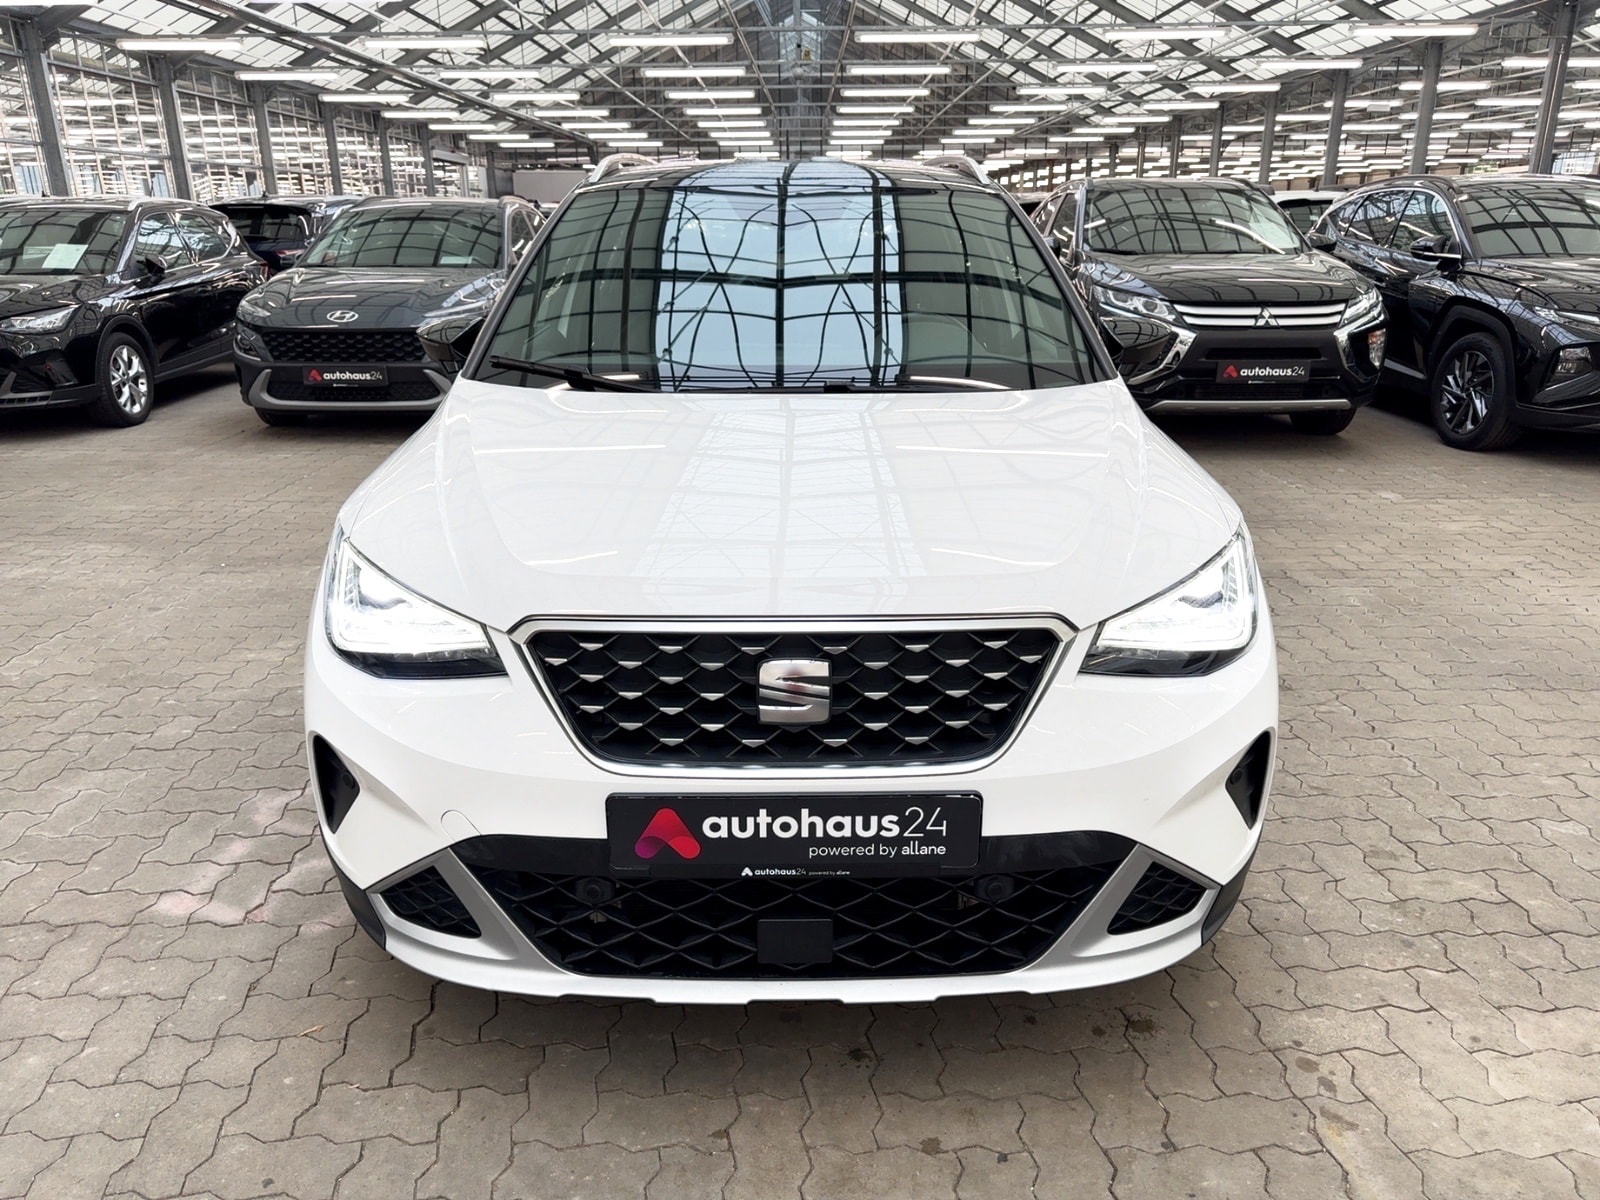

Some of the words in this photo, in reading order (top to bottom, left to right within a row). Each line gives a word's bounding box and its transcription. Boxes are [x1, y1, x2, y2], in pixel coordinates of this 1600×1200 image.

[323, 371, 383, 380] autohaus24
[1240, 366, 1305, 376] autohaus24
[702, 806, 947, 839] autohaus24
[808, 843, 875, 859] powered
[879, 843, 898, 858] by
[901, 840, 947, 855] allane
[754, 867, 807, 876] autohaus24
